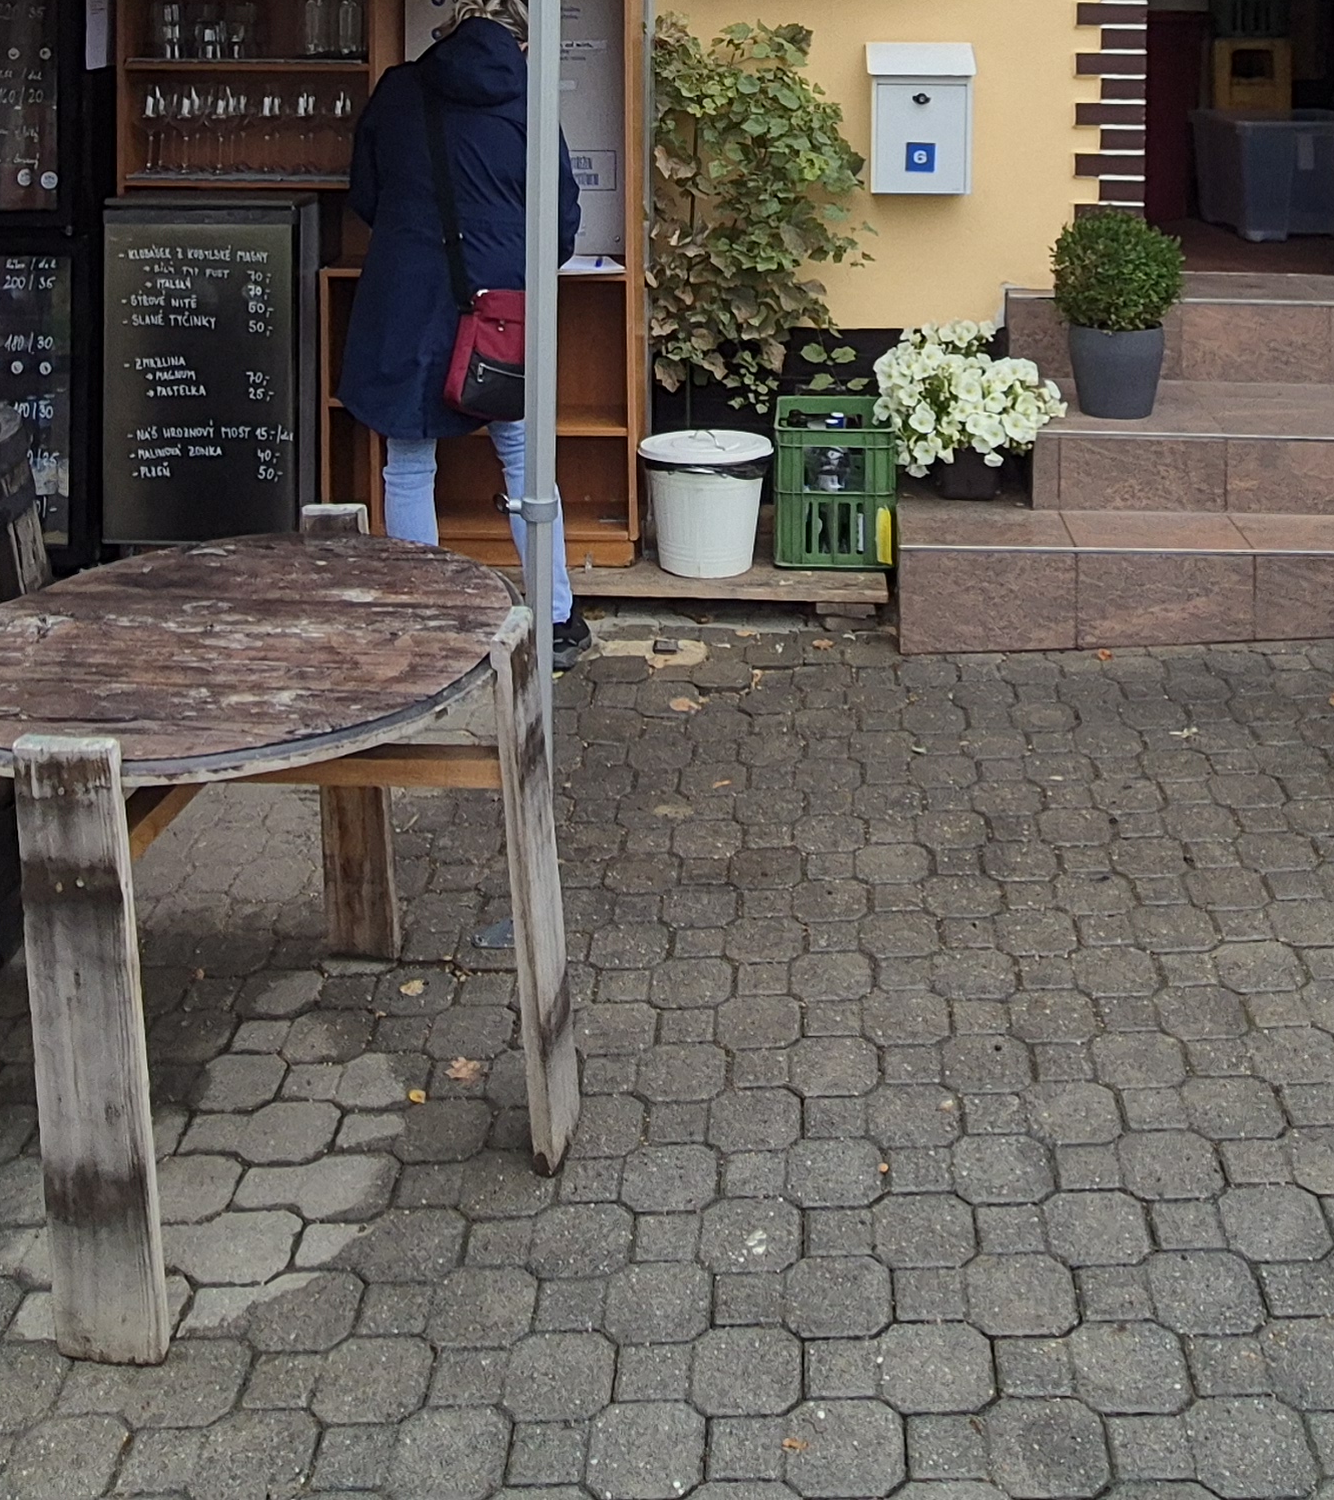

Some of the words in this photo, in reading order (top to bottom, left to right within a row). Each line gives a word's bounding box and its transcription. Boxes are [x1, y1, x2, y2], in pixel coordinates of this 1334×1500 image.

[913, 150, 927, 164] 6
[131, 308, 166, 327] SLANÉ
[168, 310, 217, 330] TYČINKY
[134, 355, 187, 370] ZMRZLINA
[162, 418, 215, 440] HROZNOVÝ
[220, 425, 252, 440] MOST
